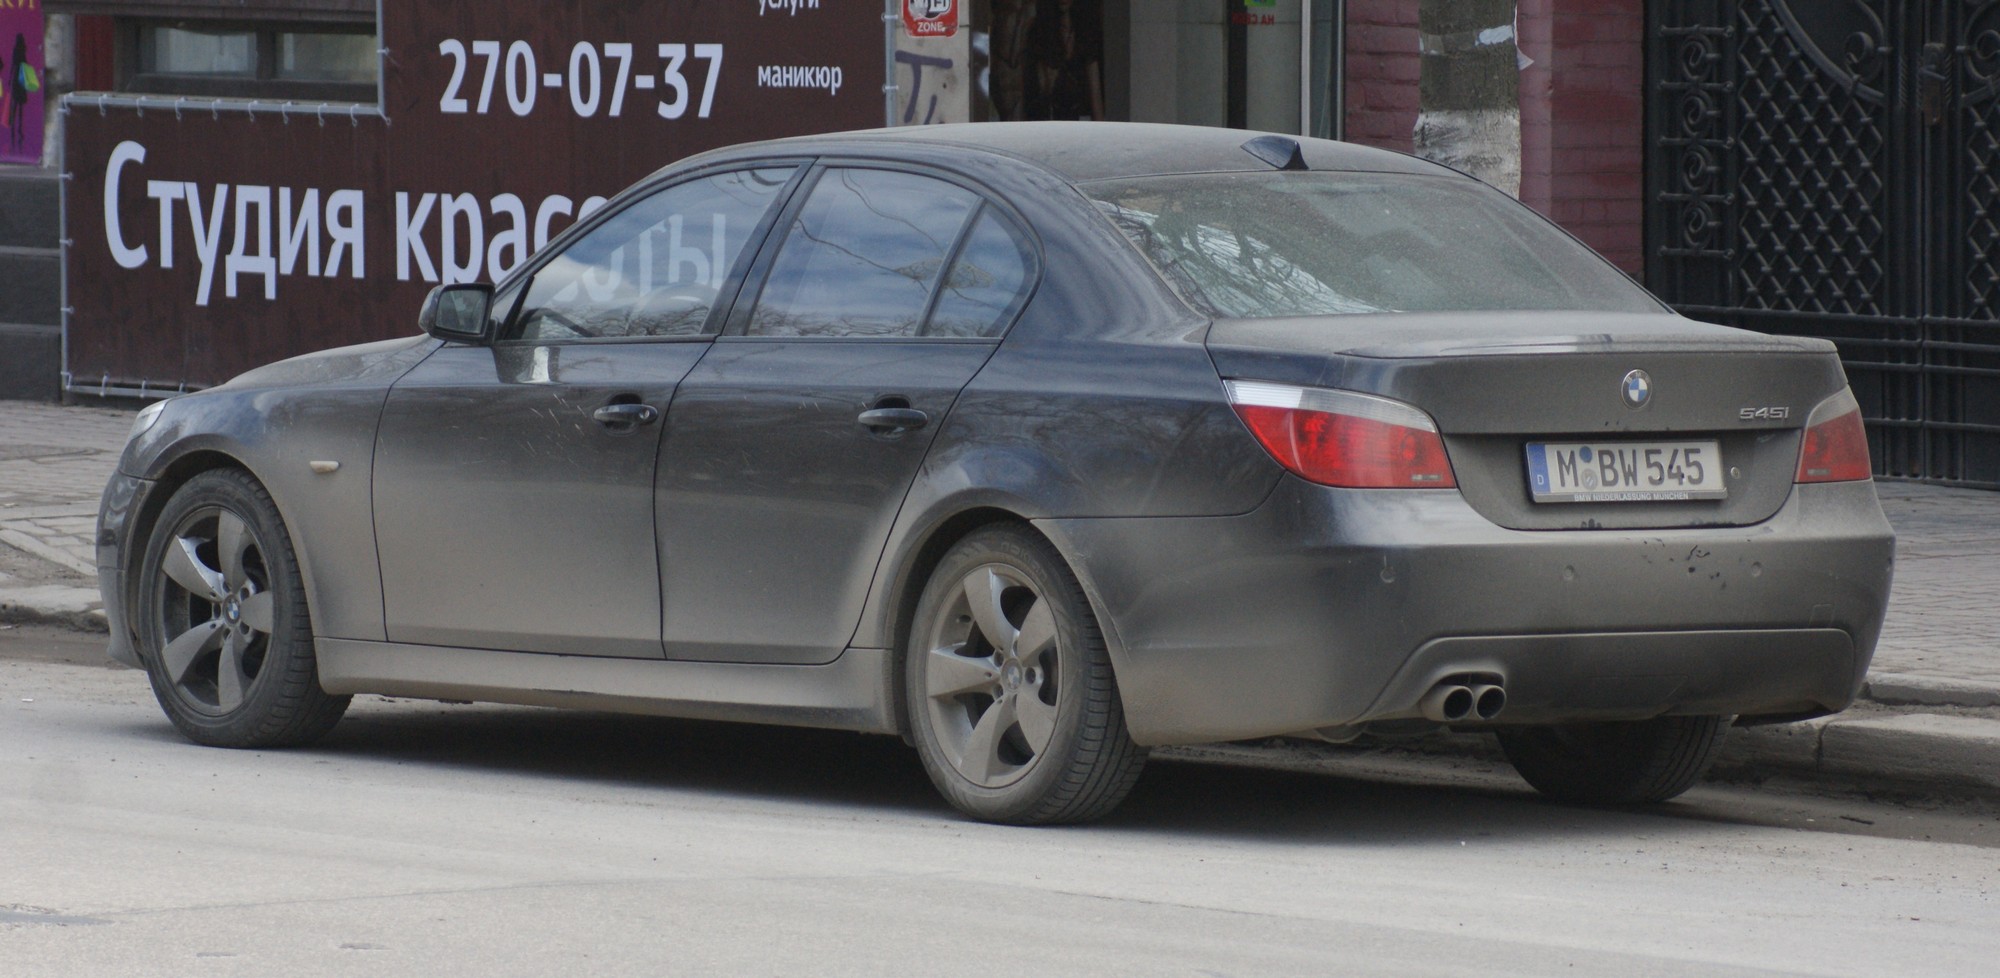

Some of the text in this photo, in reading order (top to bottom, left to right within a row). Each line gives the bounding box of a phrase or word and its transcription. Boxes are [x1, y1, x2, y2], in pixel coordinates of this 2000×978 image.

[917, 21, 942, 32] ZONE
[439, 38, 723, 119] 270-07-37
[758, 65, 842, 96] маникюр
[104, 140, 365, 306] Студия
[1556, 448, 1704, 487] M BW 545
